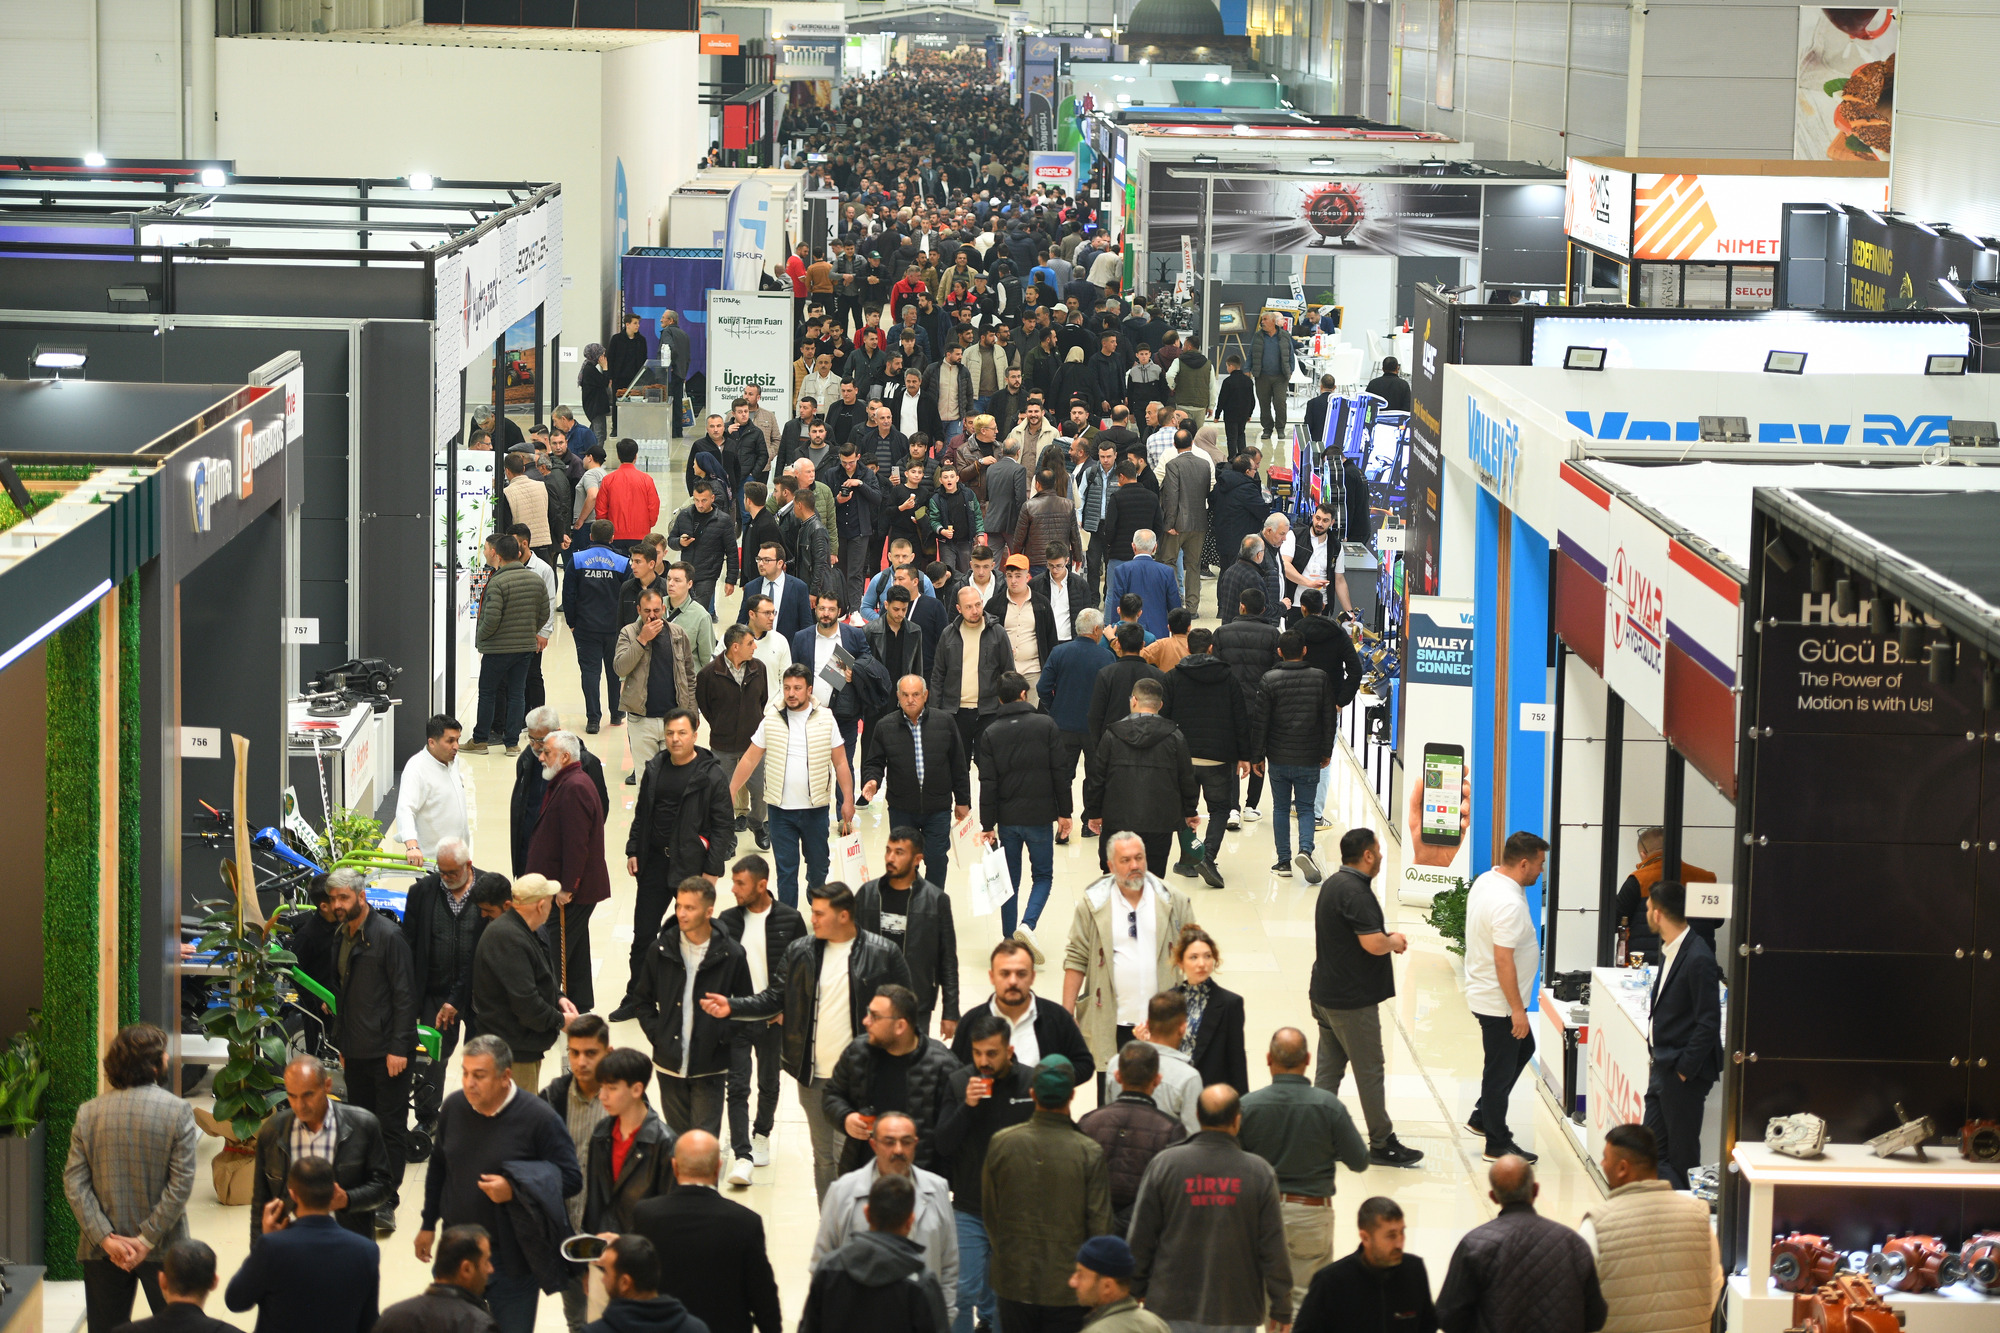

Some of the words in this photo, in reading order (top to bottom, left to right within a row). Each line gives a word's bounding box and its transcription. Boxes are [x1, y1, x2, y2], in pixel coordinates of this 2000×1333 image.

[782, 44, 836, 54] FUTURE
[1395, 211, 1435, 221] technology.
[1852, 238, 1894, 276] REDEFINING
[1850, 277, 1865, 307] THE
[1864, 282, 1886, 311] GAME
[718, 317, 740, 326] Konya
[743, 317, 763, 325] Tarım
[764, 318, 783, 326] Fuarı
[724, 369, 776, 386] Ücretsiz
[1468, 394, 1505, 495] VALLEY
[584, 569, 614, 579] ZABITA
[1628, 565, 1663, 639] UYAR
[294, 626, 308, 634] 757
[1416, 636, 1468, 651] VALLEY
[1625, 624, 1661, 675] HYDRAULIC
[1416, 648, 1464, 663] SMART
[1799, 639, 1875, 664] Gücü
[1799, 672, 1829, 687] The
[1832, 672, 1883, 688] Power
[1885, 673, 1902, 688] of
[1798, 695, 1854, 711] Motion
[1857, 696, 1869, 711] is
[1872, 697, 1906, 711] with
[1909, 698, 1933, 712] Us!
[1532, 713, 1546, 721] 752
[192, 737, 208, 746] 756
[846, 843, 861, 857] KIOTI
[1701, 895, 1720, 905] 753
[1184, 1173, 1243, 1194] ZİRVE
[1190, 1194, 1237, 1207] BETON
